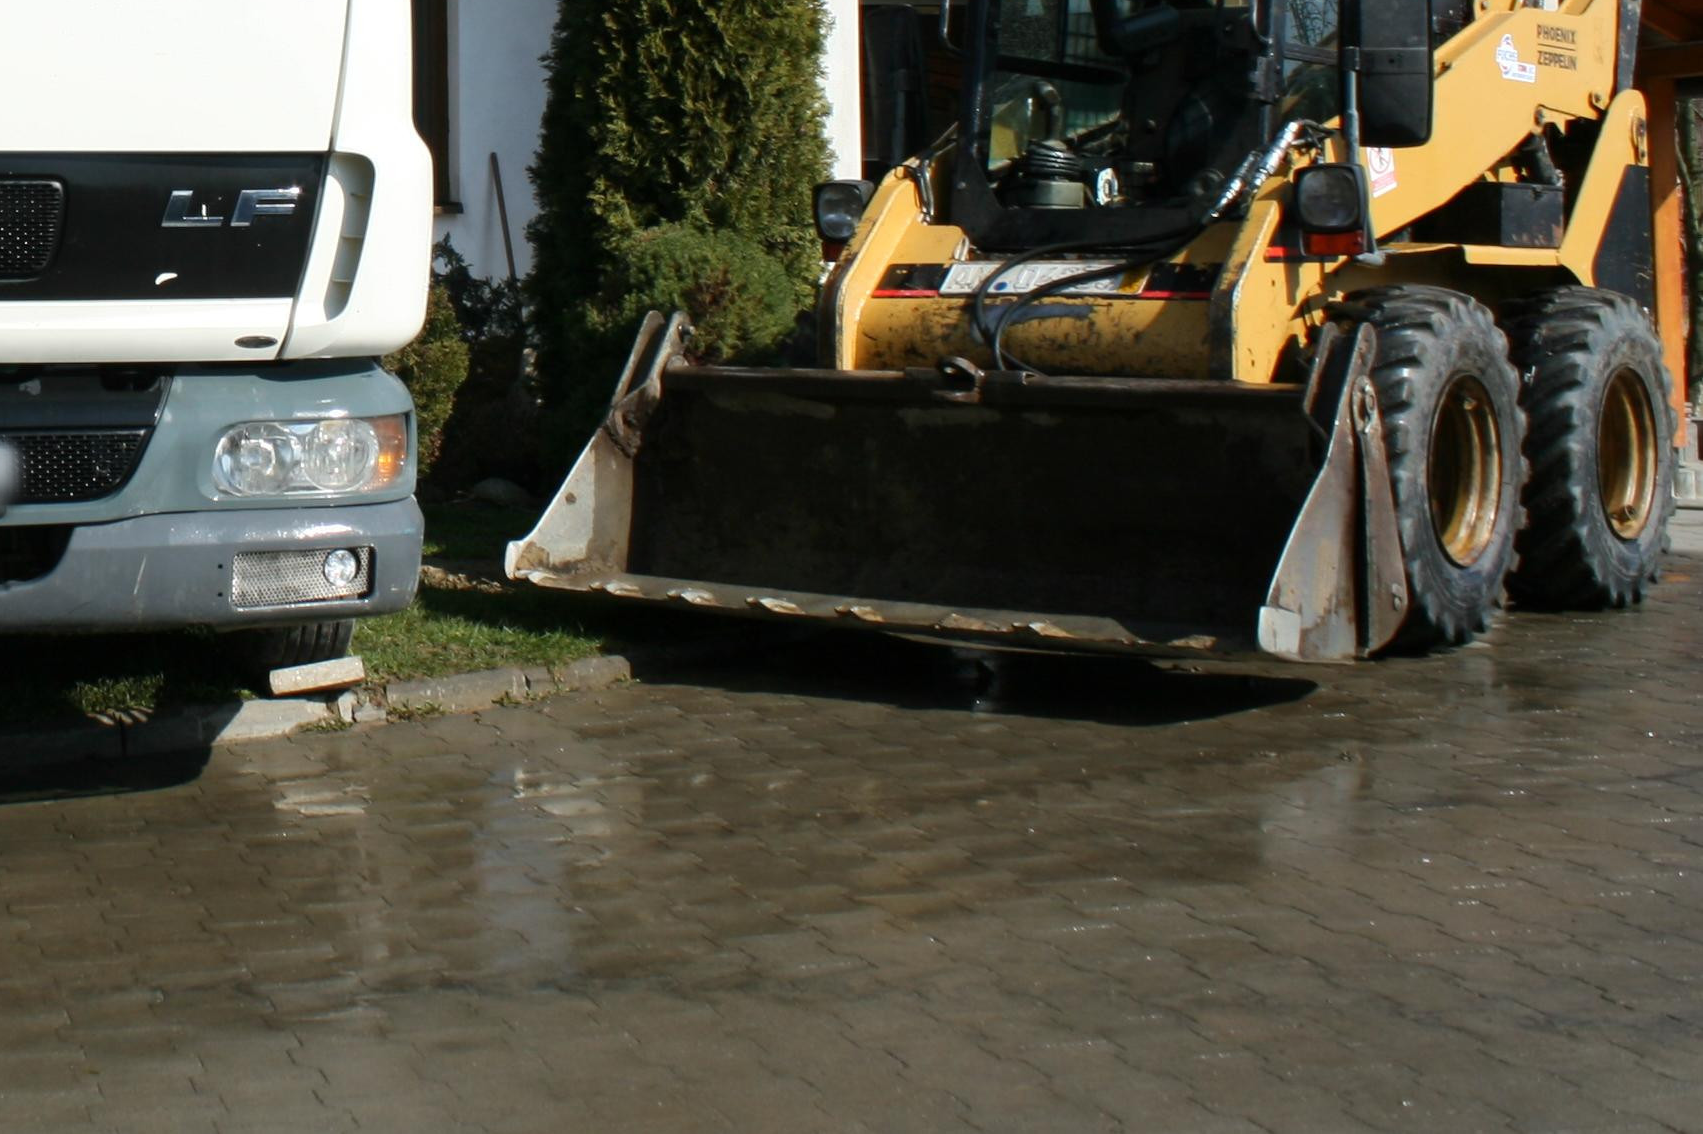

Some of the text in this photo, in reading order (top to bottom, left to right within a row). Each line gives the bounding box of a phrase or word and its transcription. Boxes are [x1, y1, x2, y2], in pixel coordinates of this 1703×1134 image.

[1537, 24, 1577, 44] PHOENIX
[1537, 50, 1577, 71] ZEPPELIN
[160, 188, 302, 227] LF
